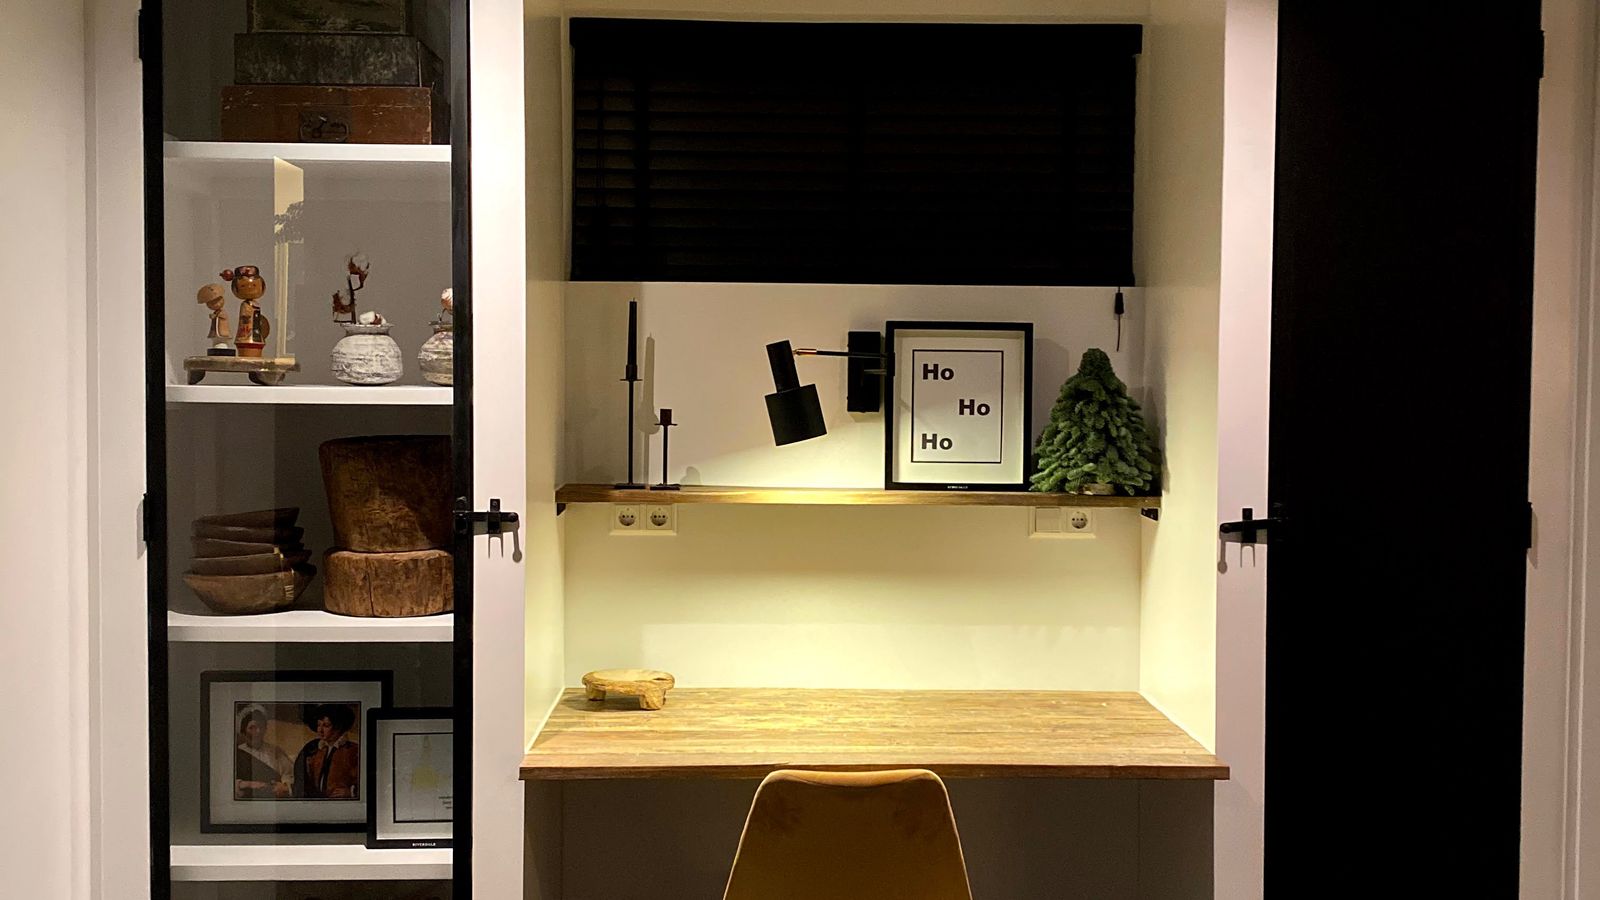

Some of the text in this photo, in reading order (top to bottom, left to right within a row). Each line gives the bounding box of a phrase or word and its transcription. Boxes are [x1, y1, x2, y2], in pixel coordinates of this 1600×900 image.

[923, 364, 954, 380] Ho
[959, 399, 990, 416] Ho
[922, 434, 952, 449] Ho
